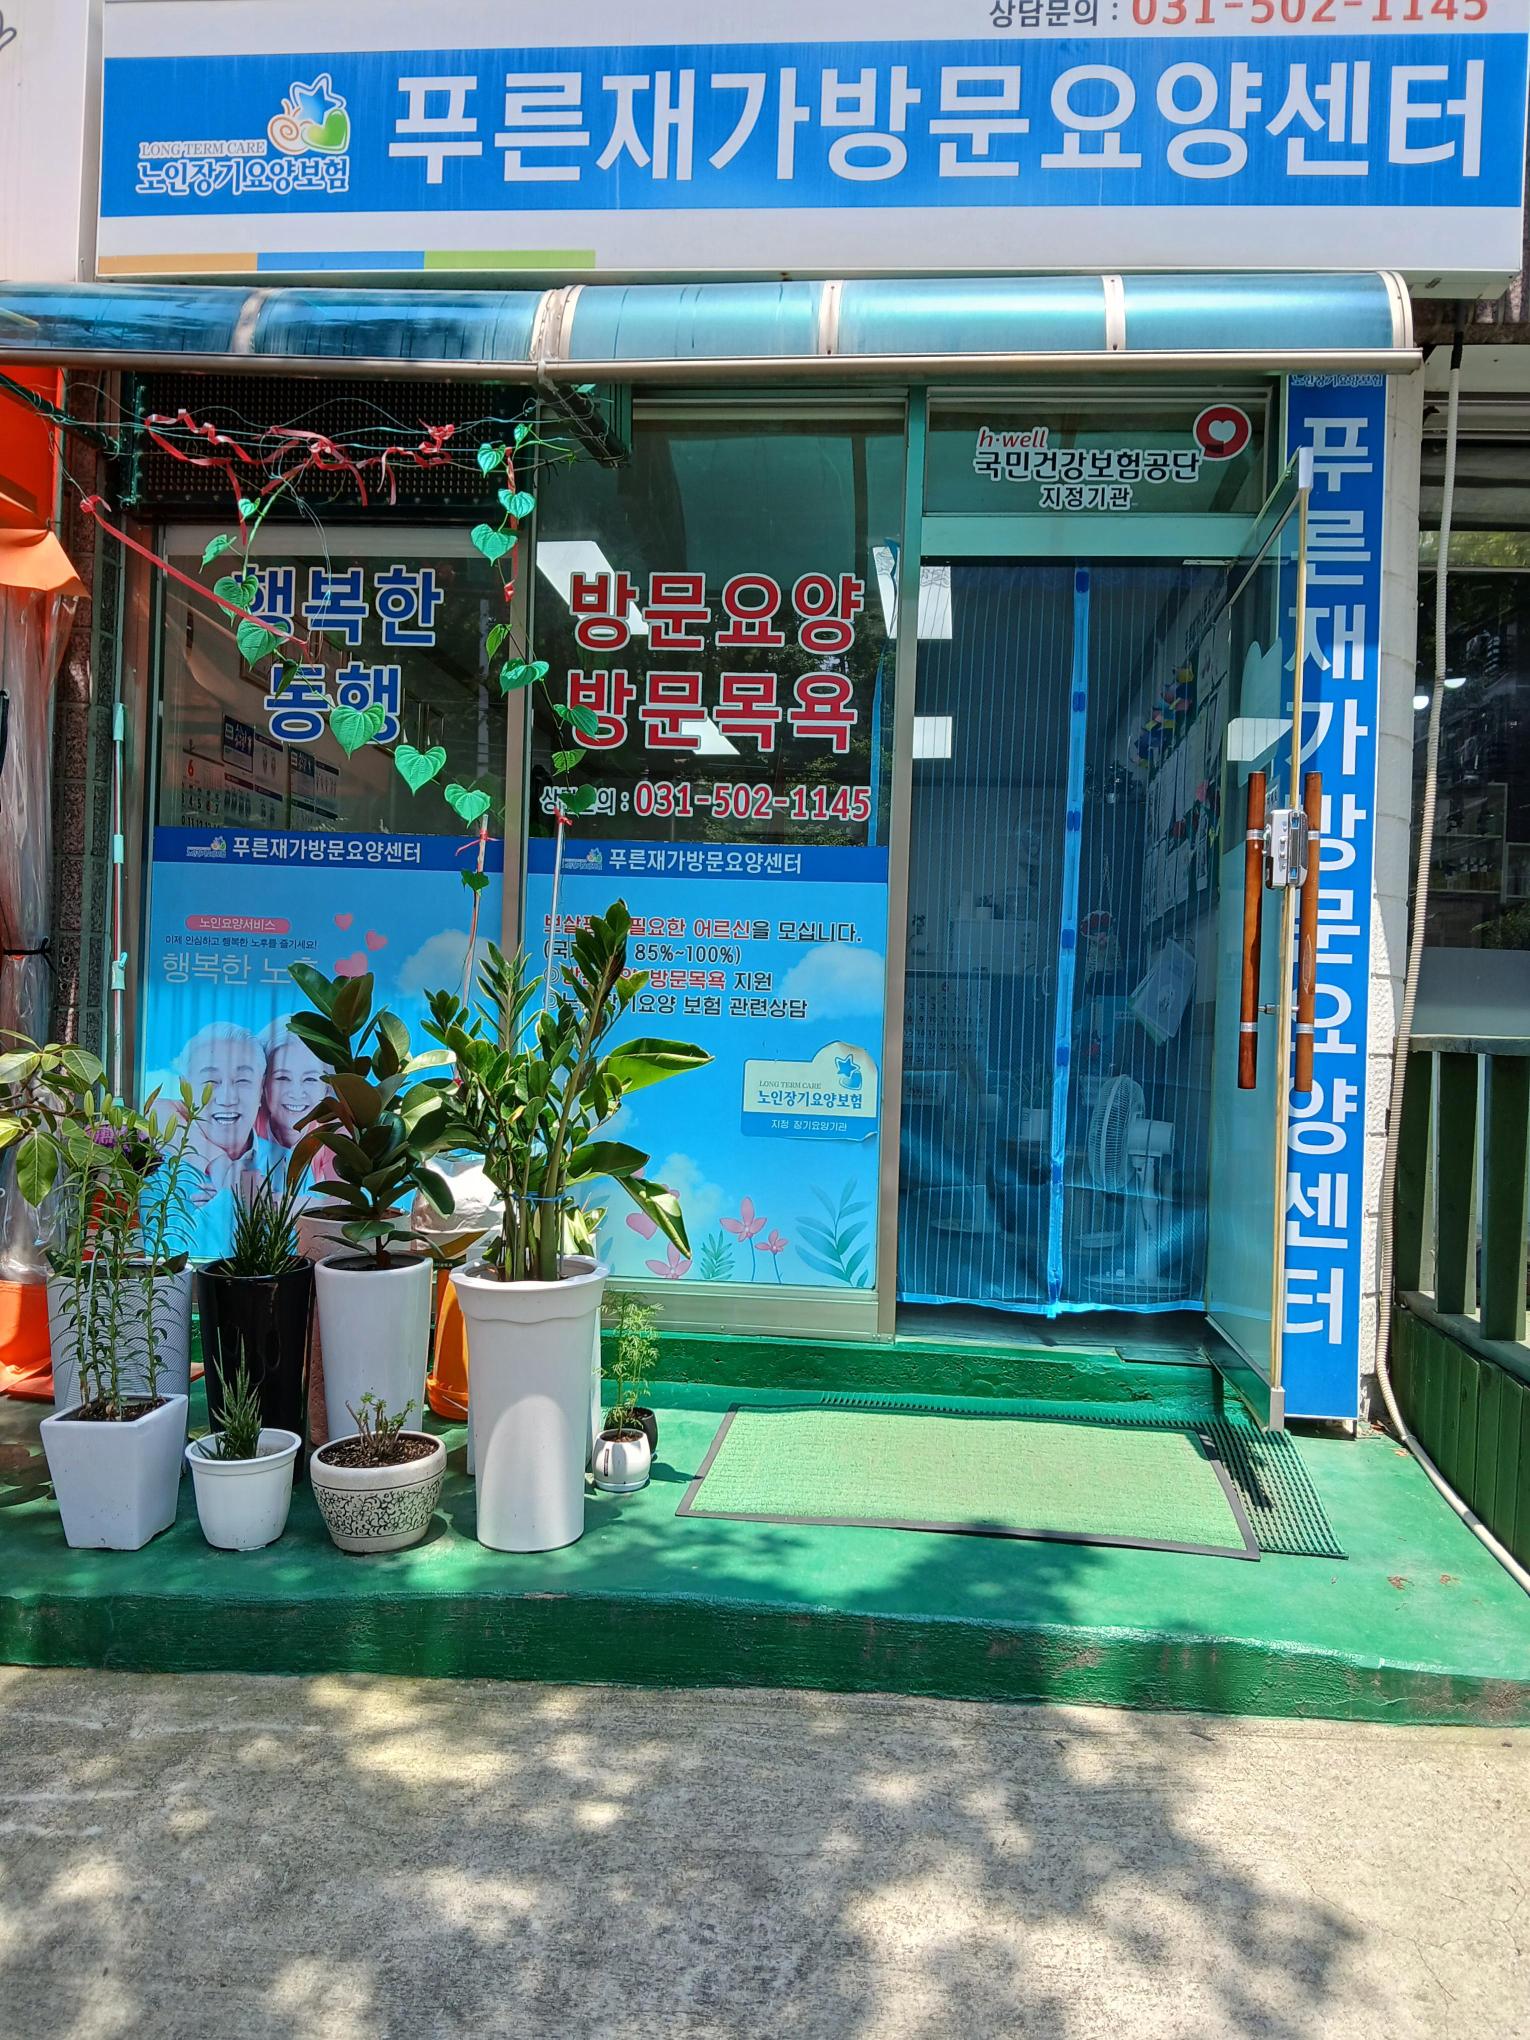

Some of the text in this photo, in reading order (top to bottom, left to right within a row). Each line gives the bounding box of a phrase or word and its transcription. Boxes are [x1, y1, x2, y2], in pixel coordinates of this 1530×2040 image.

[989, 0, 1098, 28] 상담문의
[1131, 0, 1489, 25] 031-502-1145
[388, 59, 1486, 184] 푸른재가방문요양센터
[141, 141, 266, 157] LONG TERM CARE
[136, 157, 349, 195] 노인장기요양보험
[974, 449, 1201, 482] 국민건강보험공단
[1040, 485, 1132, 510] 지정기관
[569, 571, 865, 654] 방문요양
[567, 669, 858, 753] 방문목욕
[539, 785, 616, 816] 상의
[634, 781, 872, 821] 031-502-1145
[232, 835, 422, 864] 푸른재가방문요양센터
[608, 849, 802, 874] 푸른재가방문요양센터
[200, 917, 276, 931] 노인요양서비스
[631, 917, 686, 938] 필요한
[694, 919, 772, 940] 어르신을
[778, 921, 863, 943] 모십니다.
[165, 935, 183, 945] 이제
[222, 937, 249, 948] 행복한
[163, 951, 251, 985] 행복한
[734, 972, 773, 992] 지원
[684, 995, 723, 1016] 보험
[730, 997, 809, 1019] 관련상담
[759, 1080, 781, 1088] LONG
[757, 1090, 863, 1109] 노인장기요양보험
